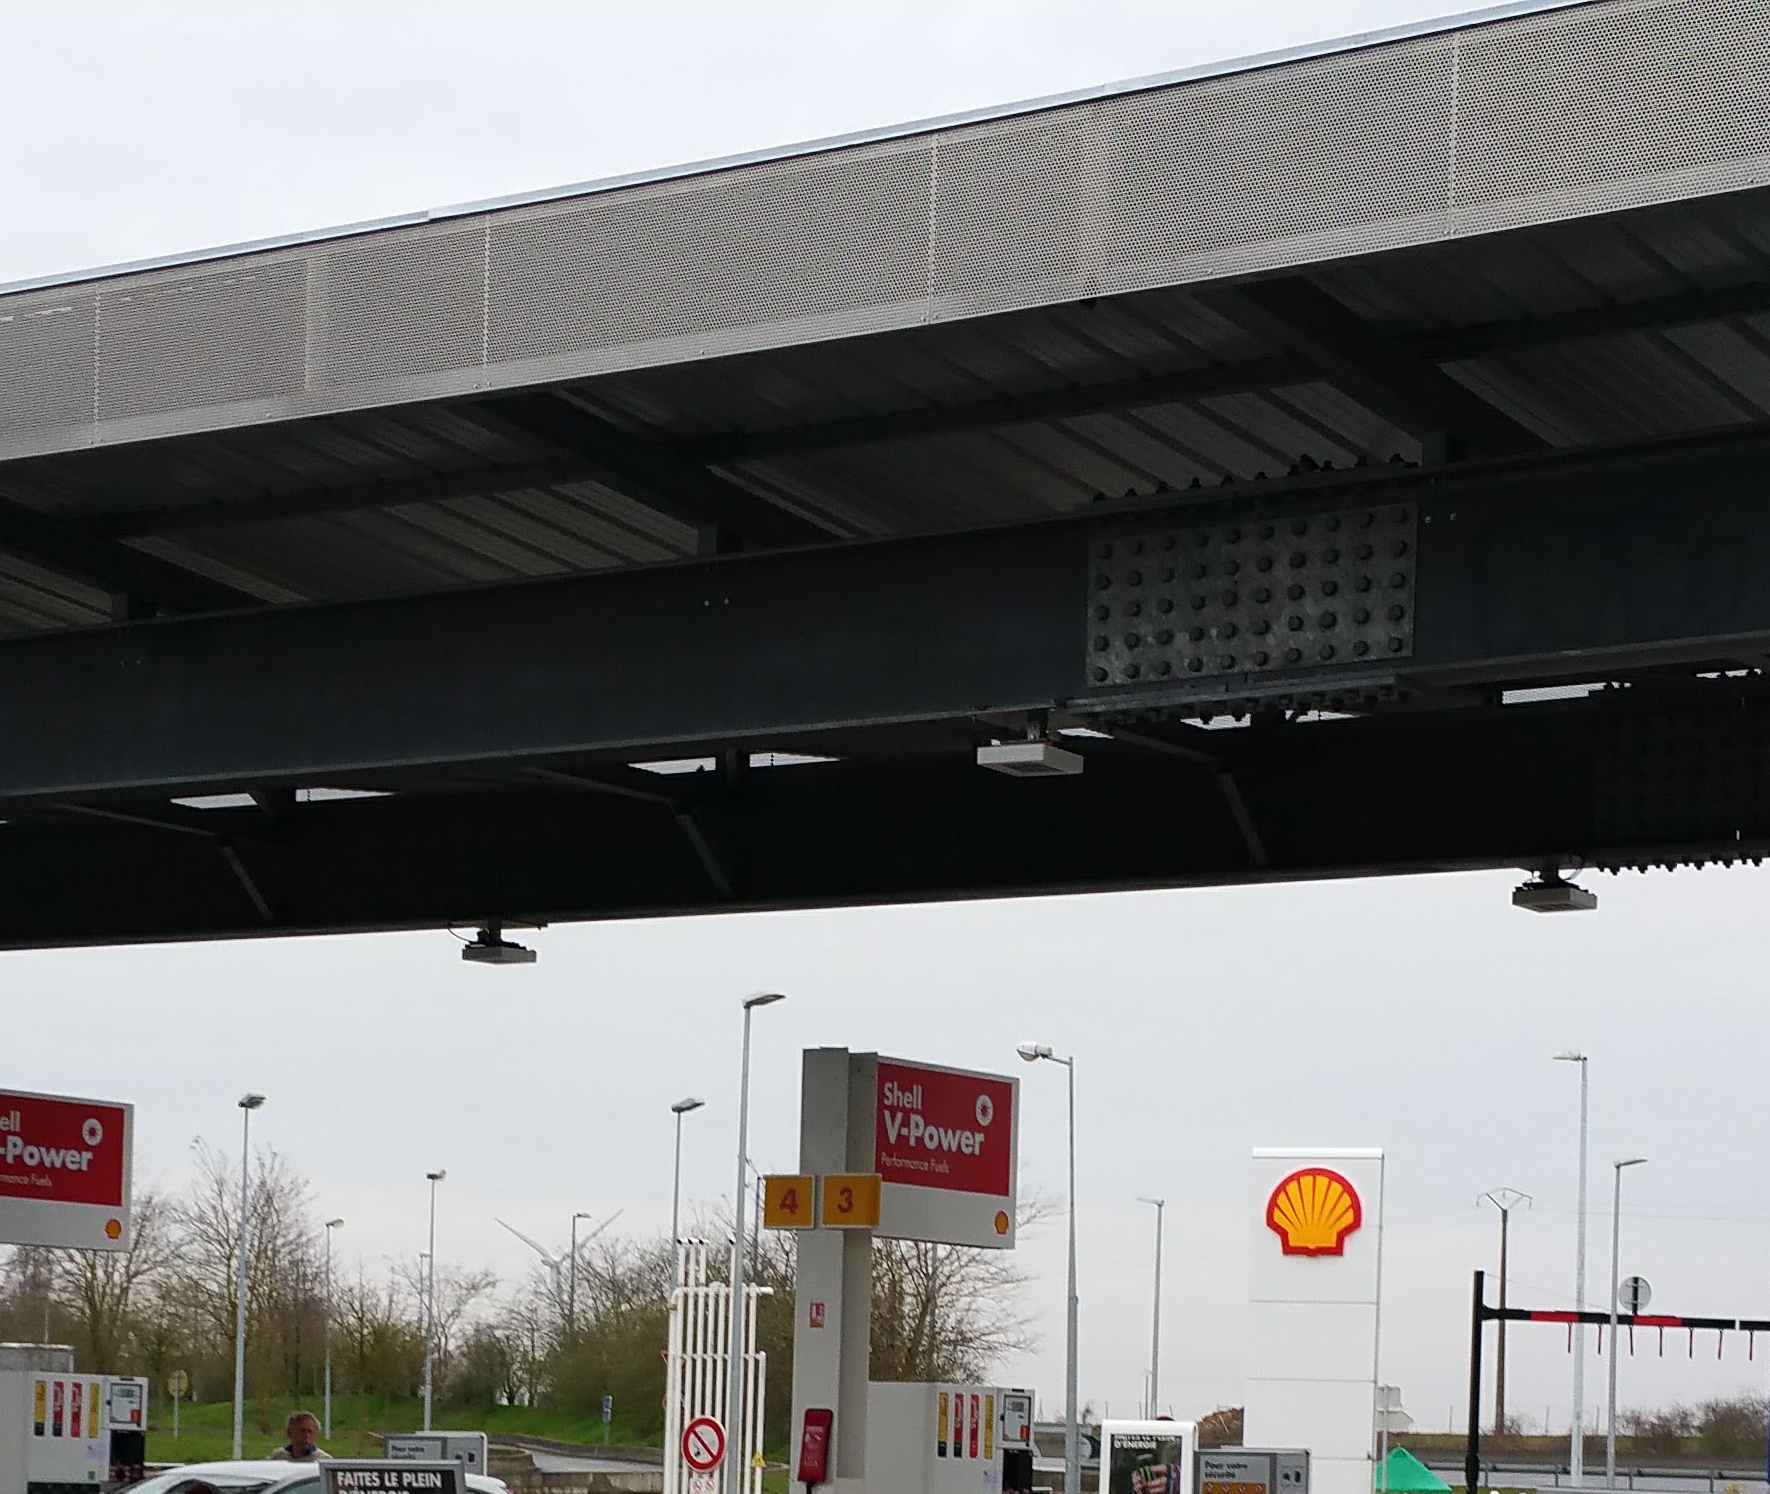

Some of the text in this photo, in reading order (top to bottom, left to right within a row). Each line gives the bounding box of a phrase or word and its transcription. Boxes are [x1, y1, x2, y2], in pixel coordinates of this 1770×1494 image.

[883, 1082, 922, 1109] Shell
[884, 1110, 984, 1156] V-Power
[881, 1151, 950, 1174] Performance Fuels
[31, 1174, 53, 1188] Fuels
[778, 1187, 798, 1215] 4
[837, 1186, 854, 1214] 3
[336, 1471, 443, 1489] FAITES LE PLEIN
